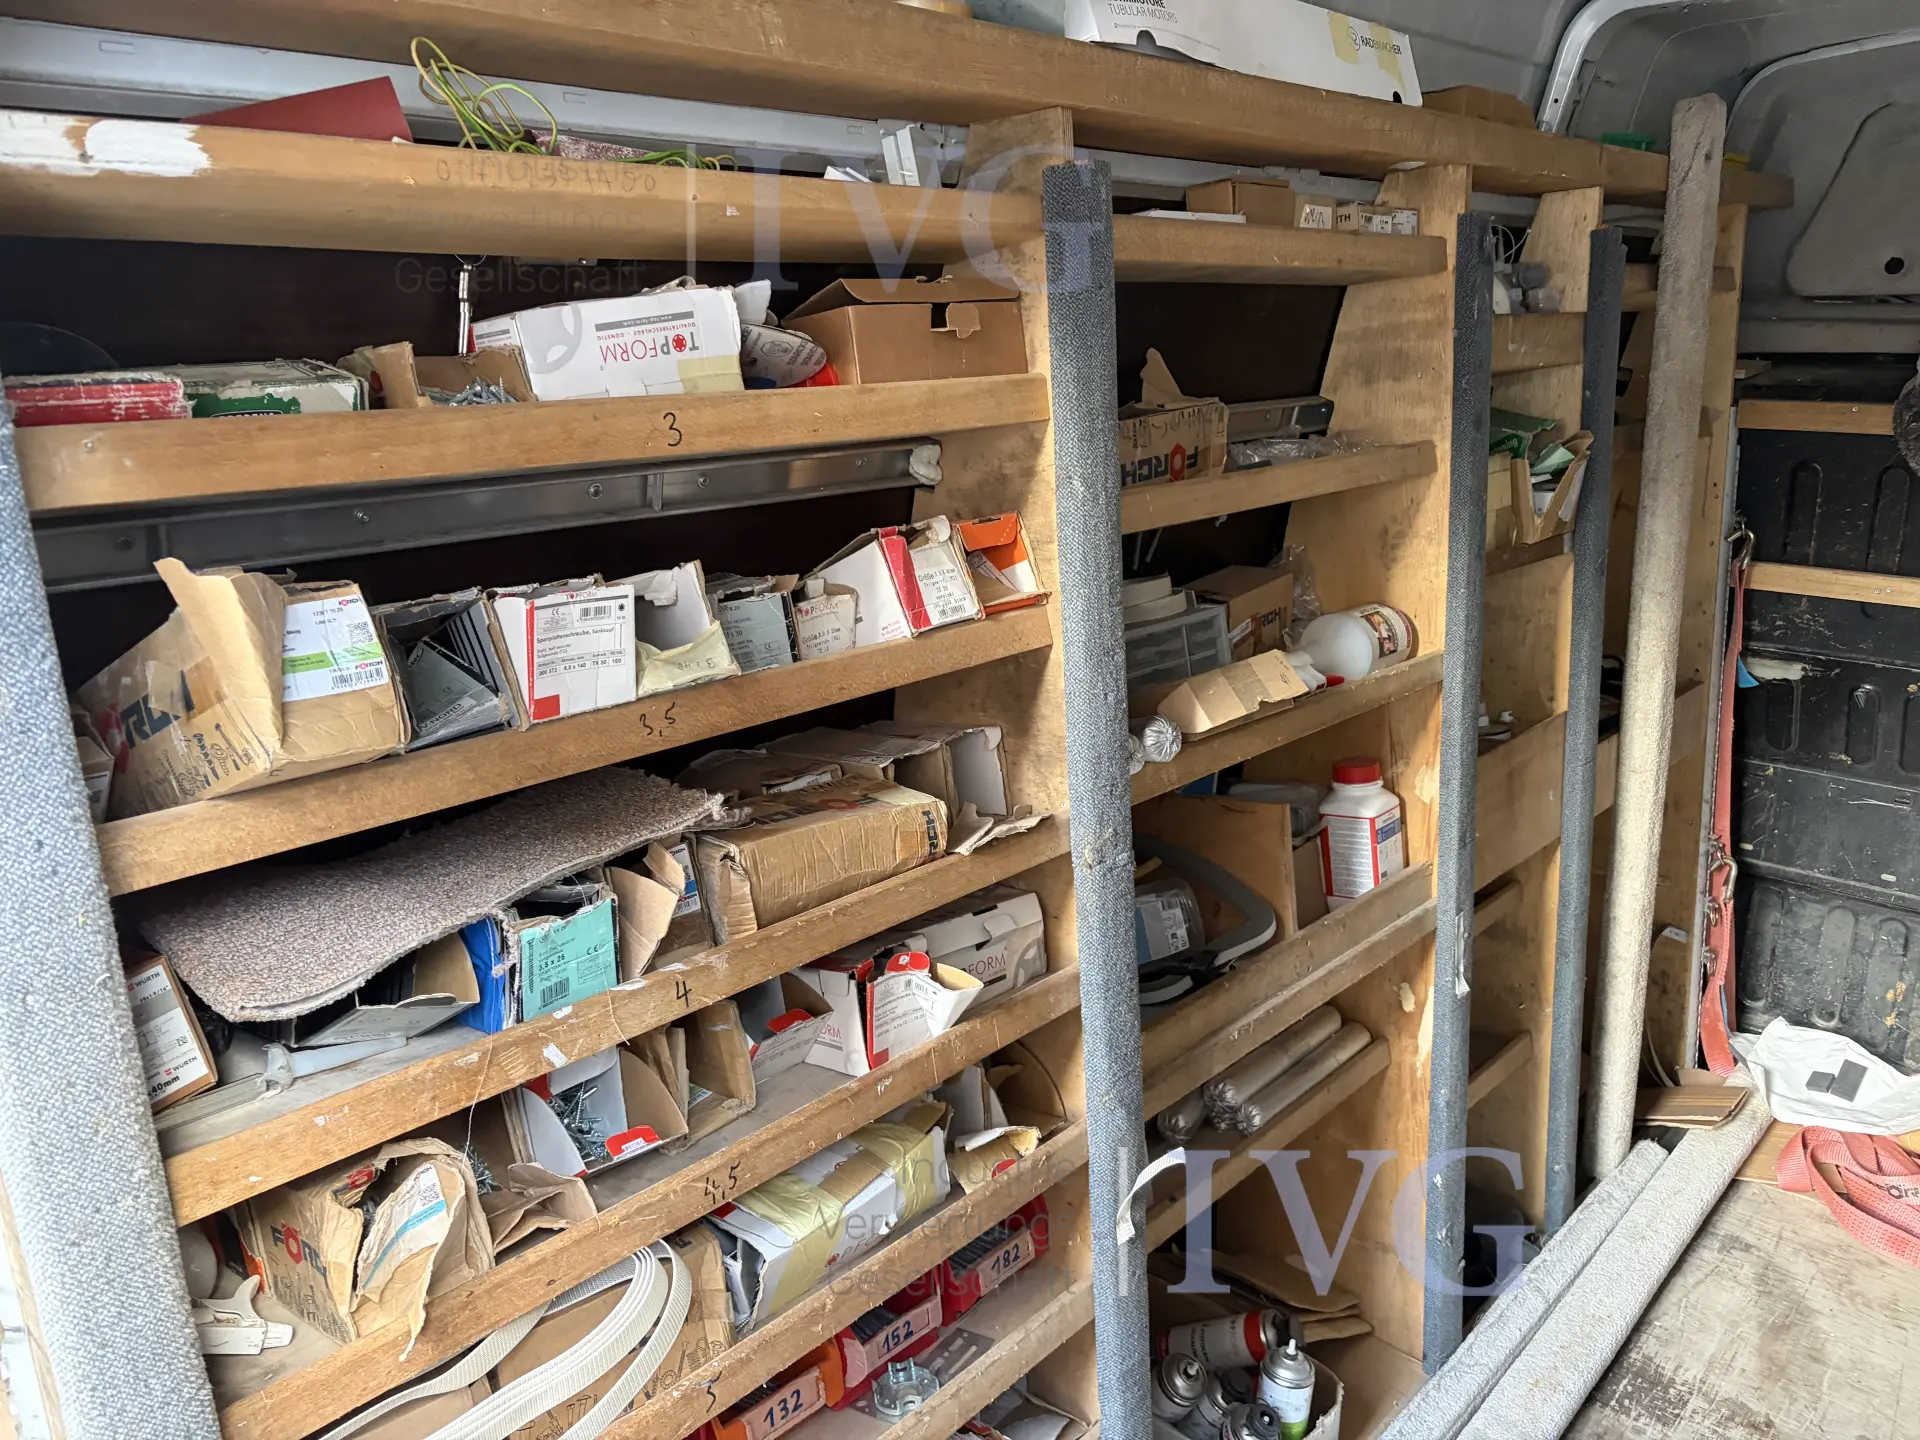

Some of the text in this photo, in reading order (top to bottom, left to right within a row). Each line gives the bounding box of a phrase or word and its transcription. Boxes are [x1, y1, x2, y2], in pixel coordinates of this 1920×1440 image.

[1107, 3, 1178, 24] TUBULAR MOTORS
[599, 331, 700, 364] TOPFORM
[663, 412, 683, 447] 3
[536, 626, 614, 644] Spanplattenschraube, Senkkopf
[639, 701, 677, 737] 3,5
[675, 980, 692, 1008] 4
[703, 1160, 742, 1205] 4,5
[991, 1243, 1021, 1274] 182
[882, 1320, 914, 1353] 152
[763, 1388, 804, 1428] 132
